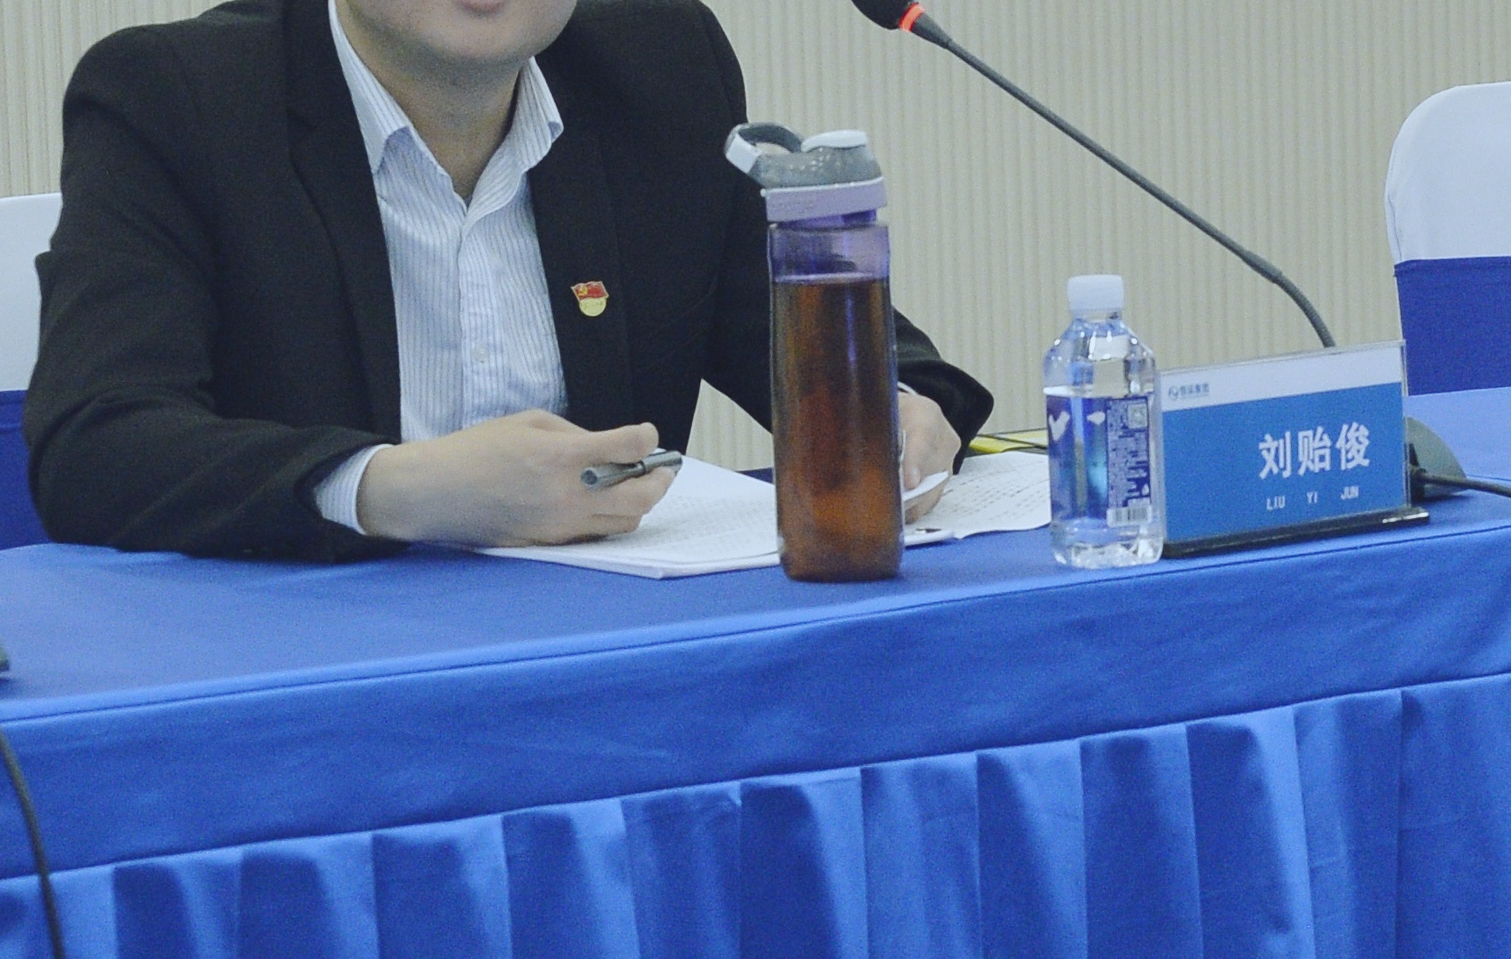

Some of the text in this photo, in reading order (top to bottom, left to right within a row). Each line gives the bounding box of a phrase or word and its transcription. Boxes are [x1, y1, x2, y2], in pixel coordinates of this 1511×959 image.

[1258, 421, 1370, 480] 刘贻俊
[1266, 485, 1359, 511] LIU YI JUN
